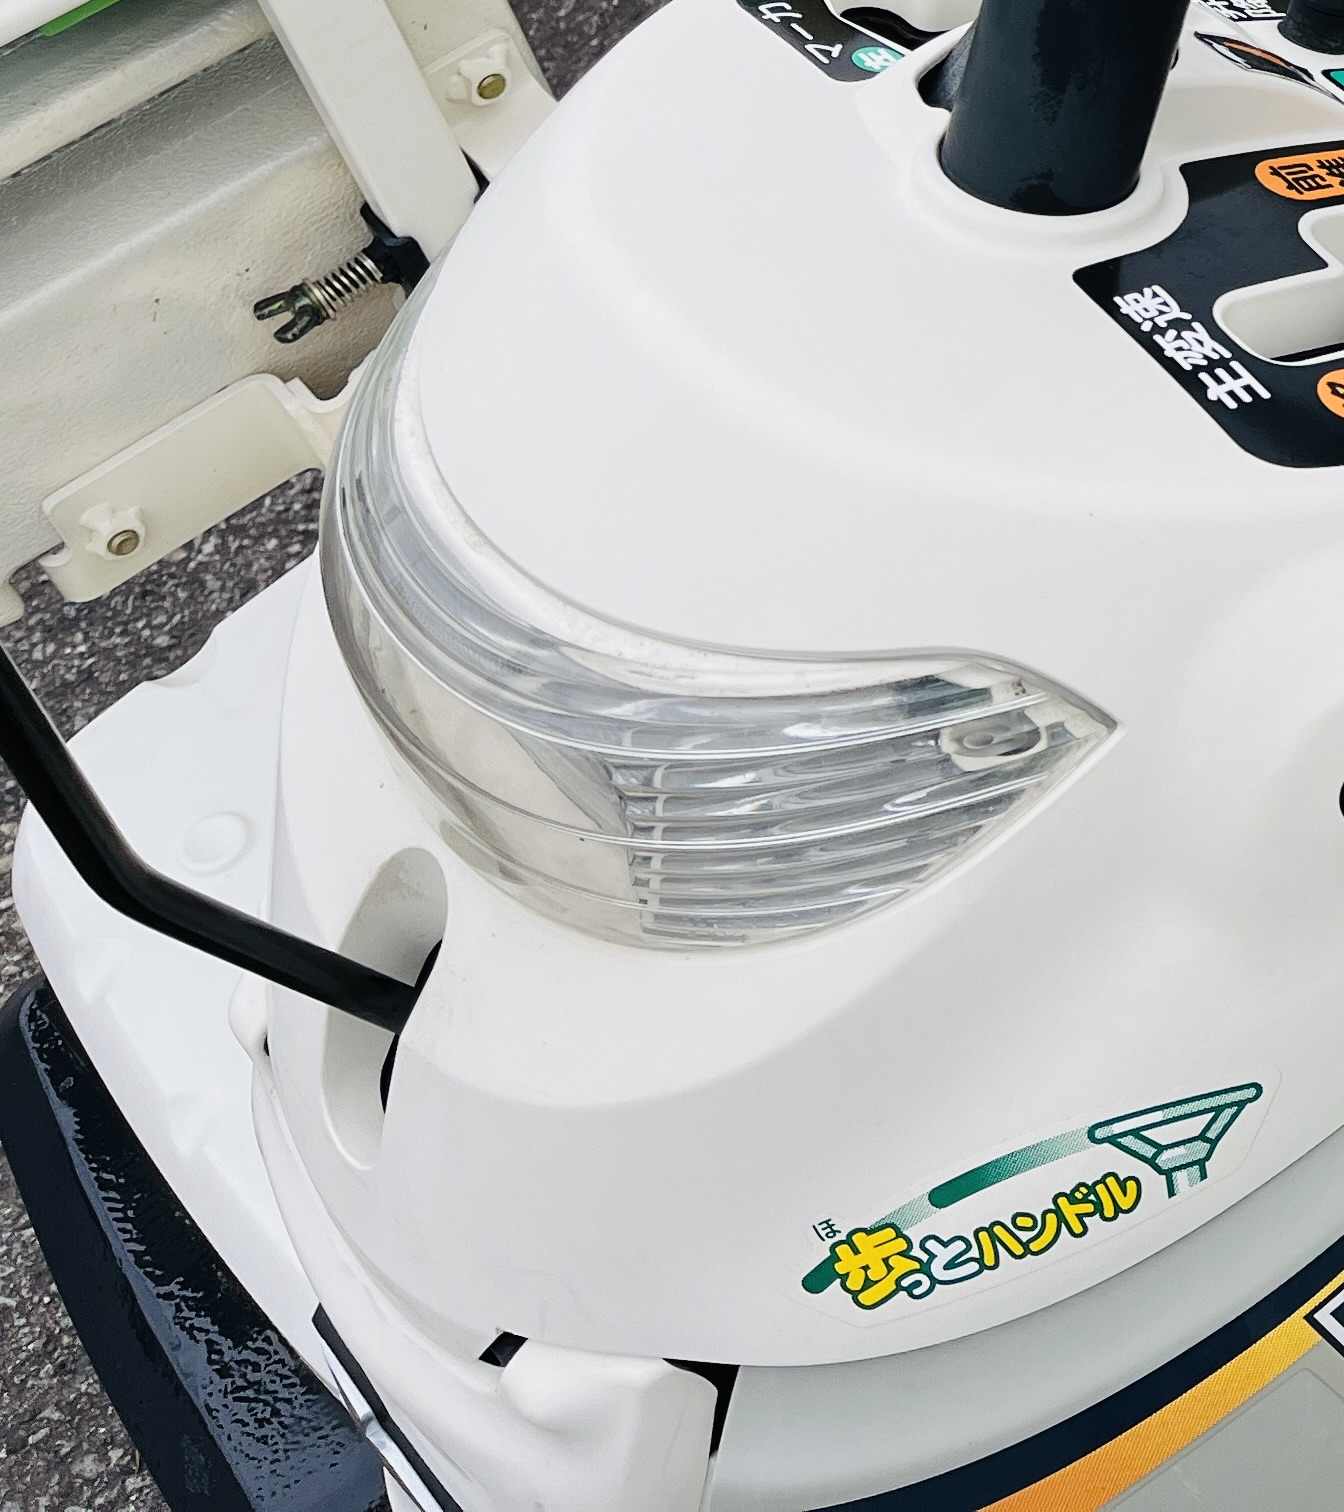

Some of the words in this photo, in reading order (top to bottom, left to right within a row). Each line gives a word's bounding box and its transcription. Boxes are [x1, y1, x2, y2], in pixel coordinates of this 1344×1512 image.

[758, 2, 843, 64] マーカ
[1113, 283, 1272, 410] 主変速
[812, 1218, 842, 1241] ほ
